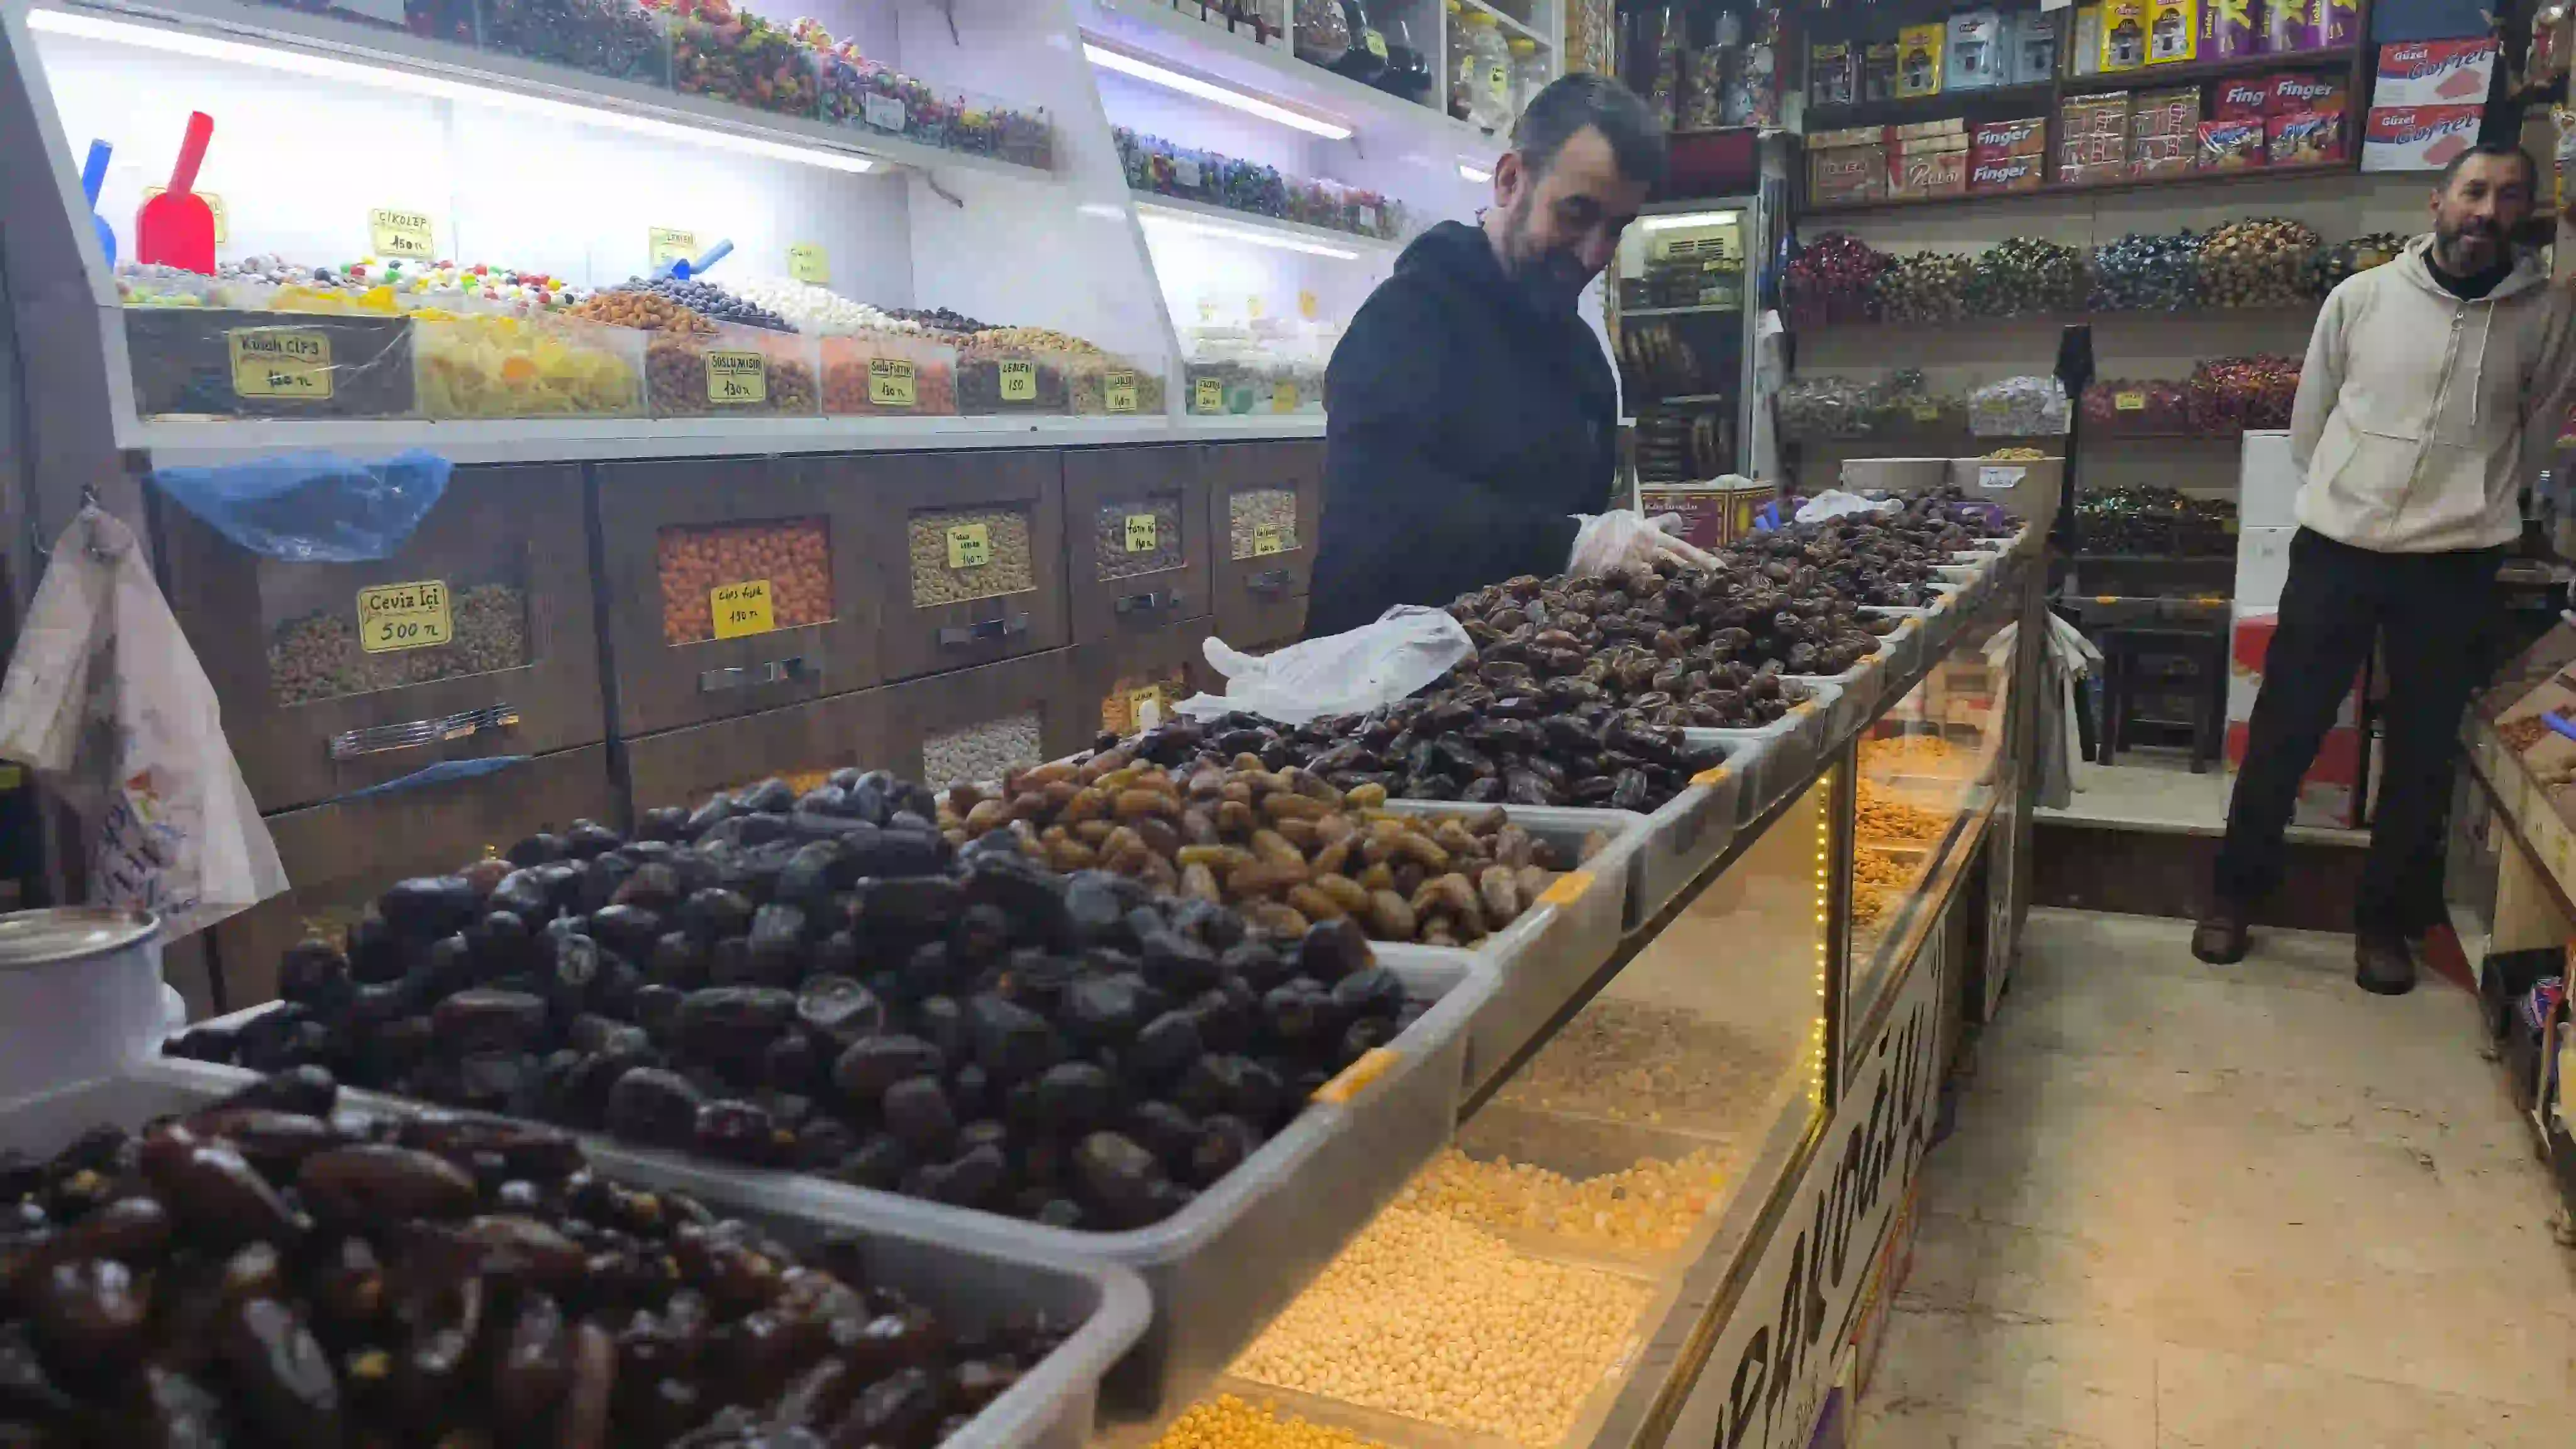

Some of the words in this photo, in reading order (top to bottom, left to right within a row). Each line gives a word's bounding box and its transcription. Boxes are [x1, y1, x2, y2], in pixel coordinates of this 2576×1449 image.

[2277, 80, 2332, 100] Finger
[1977, 129, 2031, 146] Finger
[1973, 165, 2028, 182] Finger
[724, 380, 741, 396] 130
[370, 592, 414, 610] Ceviz
[380, 622, 418, 641] 500
